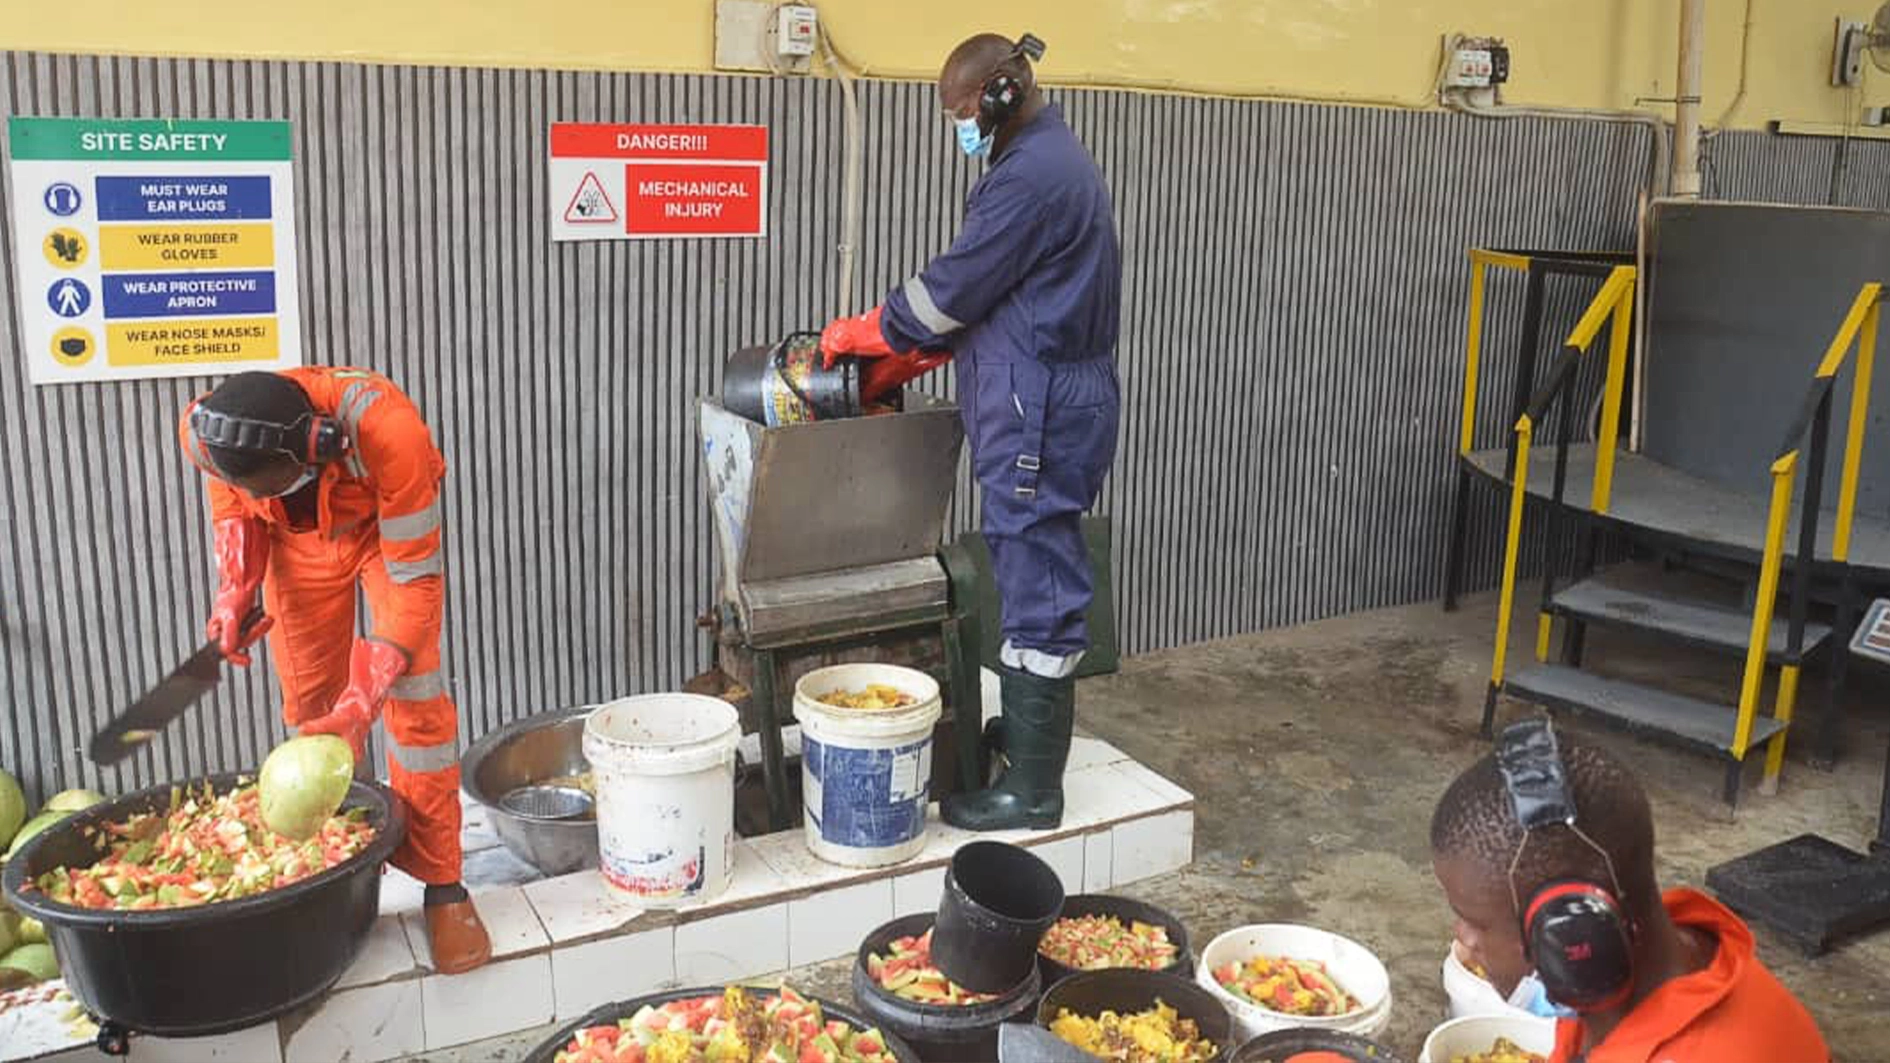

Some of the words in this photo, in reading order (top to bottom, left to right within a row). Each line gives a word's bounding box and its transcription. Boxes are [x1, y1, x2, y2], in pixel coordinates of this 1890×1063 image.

[82, 133, 133, 151] SITE
[138, 133, 228, 151] SAFETY
[617, 133, 708, 151] DANGER!!!
[141, 185, 182, 196] MUST
[186, 185, 228, 196] WEAR
[638, 181, 749, 197] MECHANICAL
[147, 201, 177, 212] EAR
[179, 200, 226, 212] PLUGS
[665, 203, 723, 218] INJURY
[139, 234, 181, 245] WEAR
[184, 233, 239, 244] RUBBER
[161, 249, 218, 260] GLOVES
[124, 282, 168, 294] WEAR
[170, 279, 256, 293] PROTECTIVE
[167, 296, 217, 308] APRON
[126, 331, 169, 342] WEAR
[171, 328, 209, 340] NOSE
[154, 345, 191, 356] FACE
[193, 343, 241, 355] SHIELD
